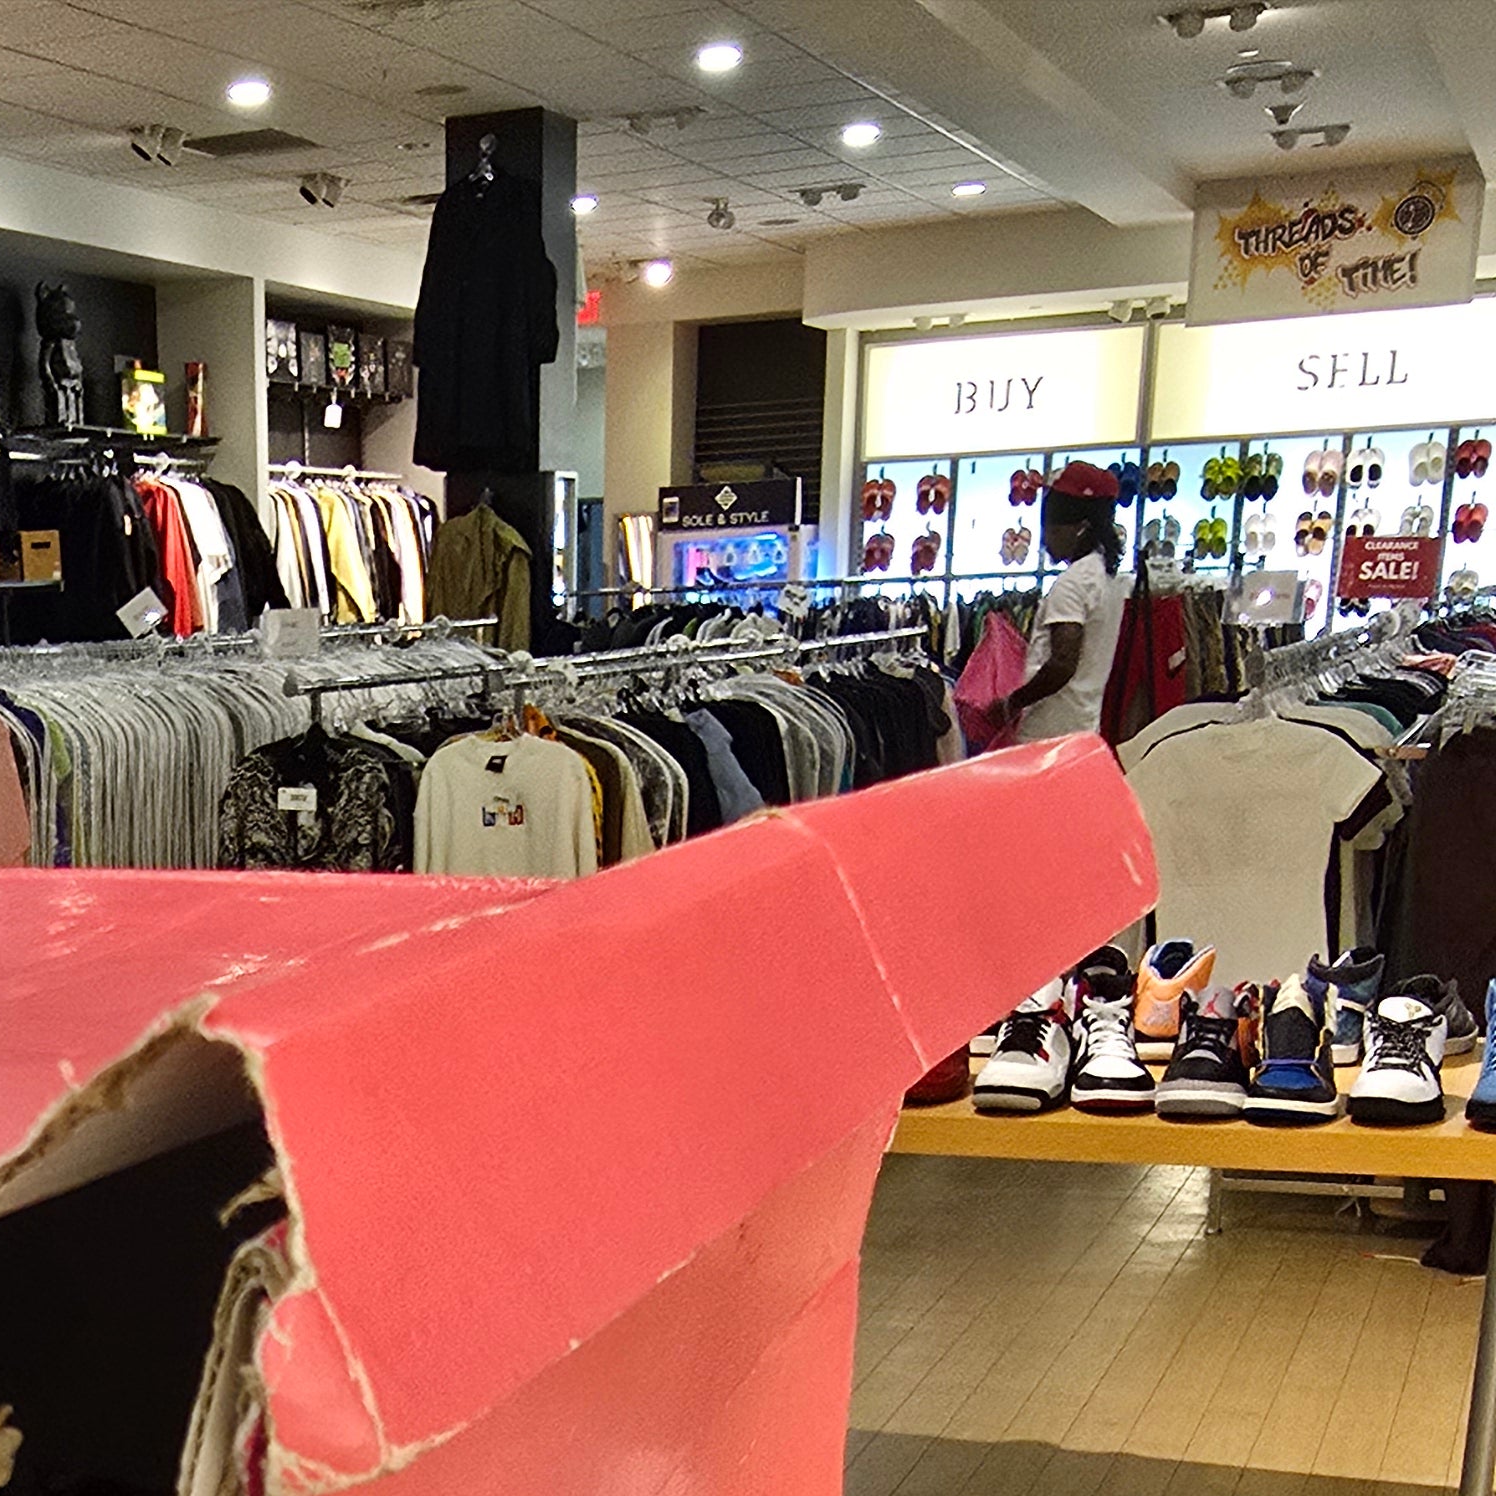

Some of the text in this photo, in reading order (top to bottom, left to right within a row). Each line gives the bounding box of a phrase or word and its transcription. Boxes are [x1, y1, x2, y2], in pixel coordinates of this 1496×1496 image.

[1236, 206, 1357, 258] THREADS
[1296, 244, 1332, 280] OF
[1296, 350, 1409, 391] SELL
[954, 376, 1044, 414] BUY
[683, 511, 769, 527] SOLE & STYLE
[1364, 541, 1419, 550] CLEARANCE
[1358, 561, 1419, 580] SALE!
